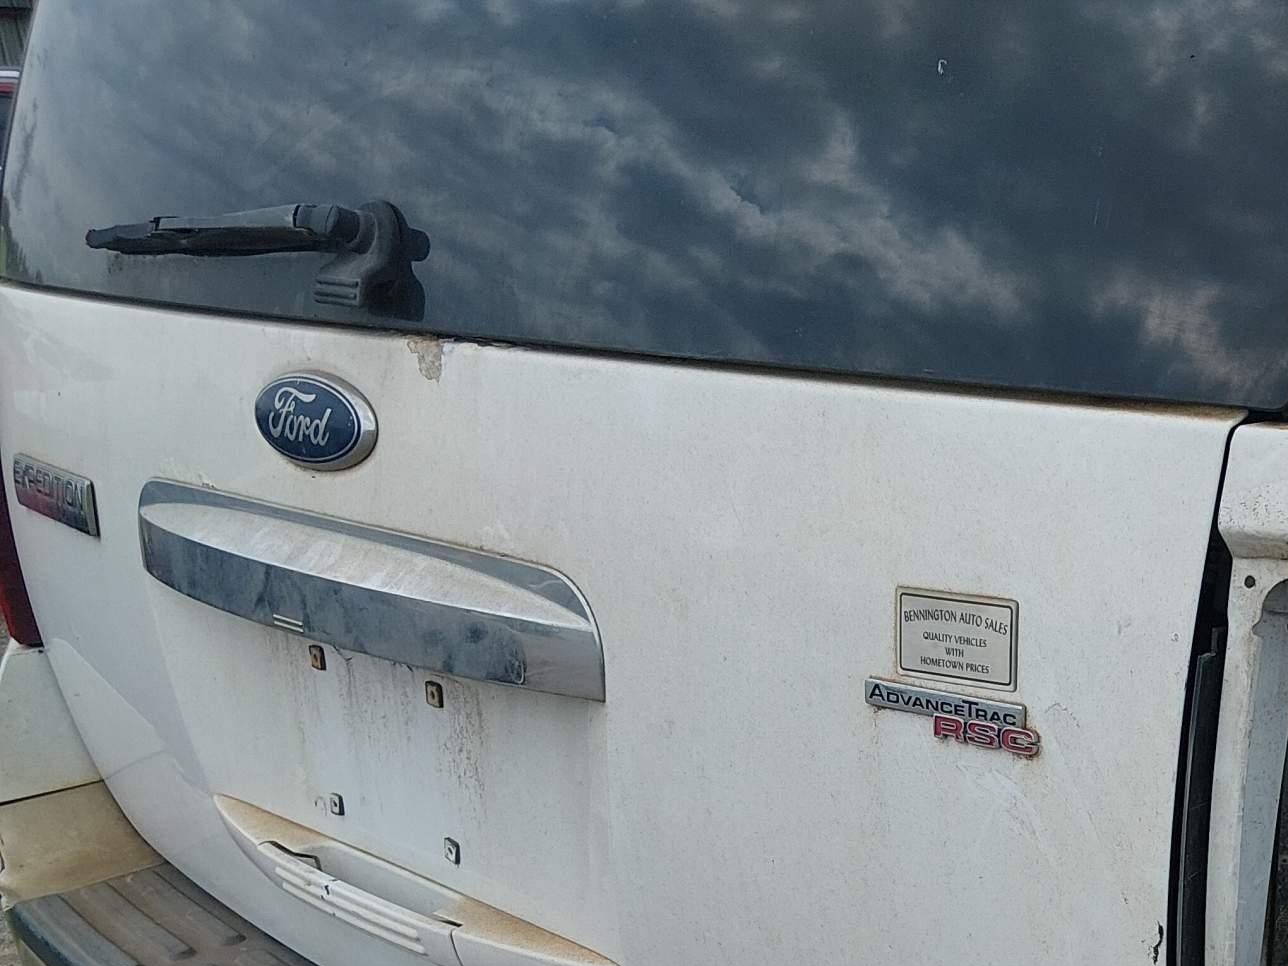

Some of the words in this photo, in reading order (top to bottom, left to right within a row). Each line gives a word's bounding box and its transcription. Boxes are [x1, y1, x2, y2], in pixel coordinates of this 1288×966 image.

[269, 387, 332, 446] Ford
[904, 609, 957, 623] BENNINGTON
[959, 611, 983, 627] AUTO
[984, 617, 1008, 635] SALES
[922, 631, 953, 644] QUALITY
[954, 635, 987, 647] VEHICLES
[945, 647, 964, 657] WITH
[920, 655, 964, 671] HOMETOWN
[965, 662, 989, 673] PRICES
[933, 714, 1041, 755] RSC
